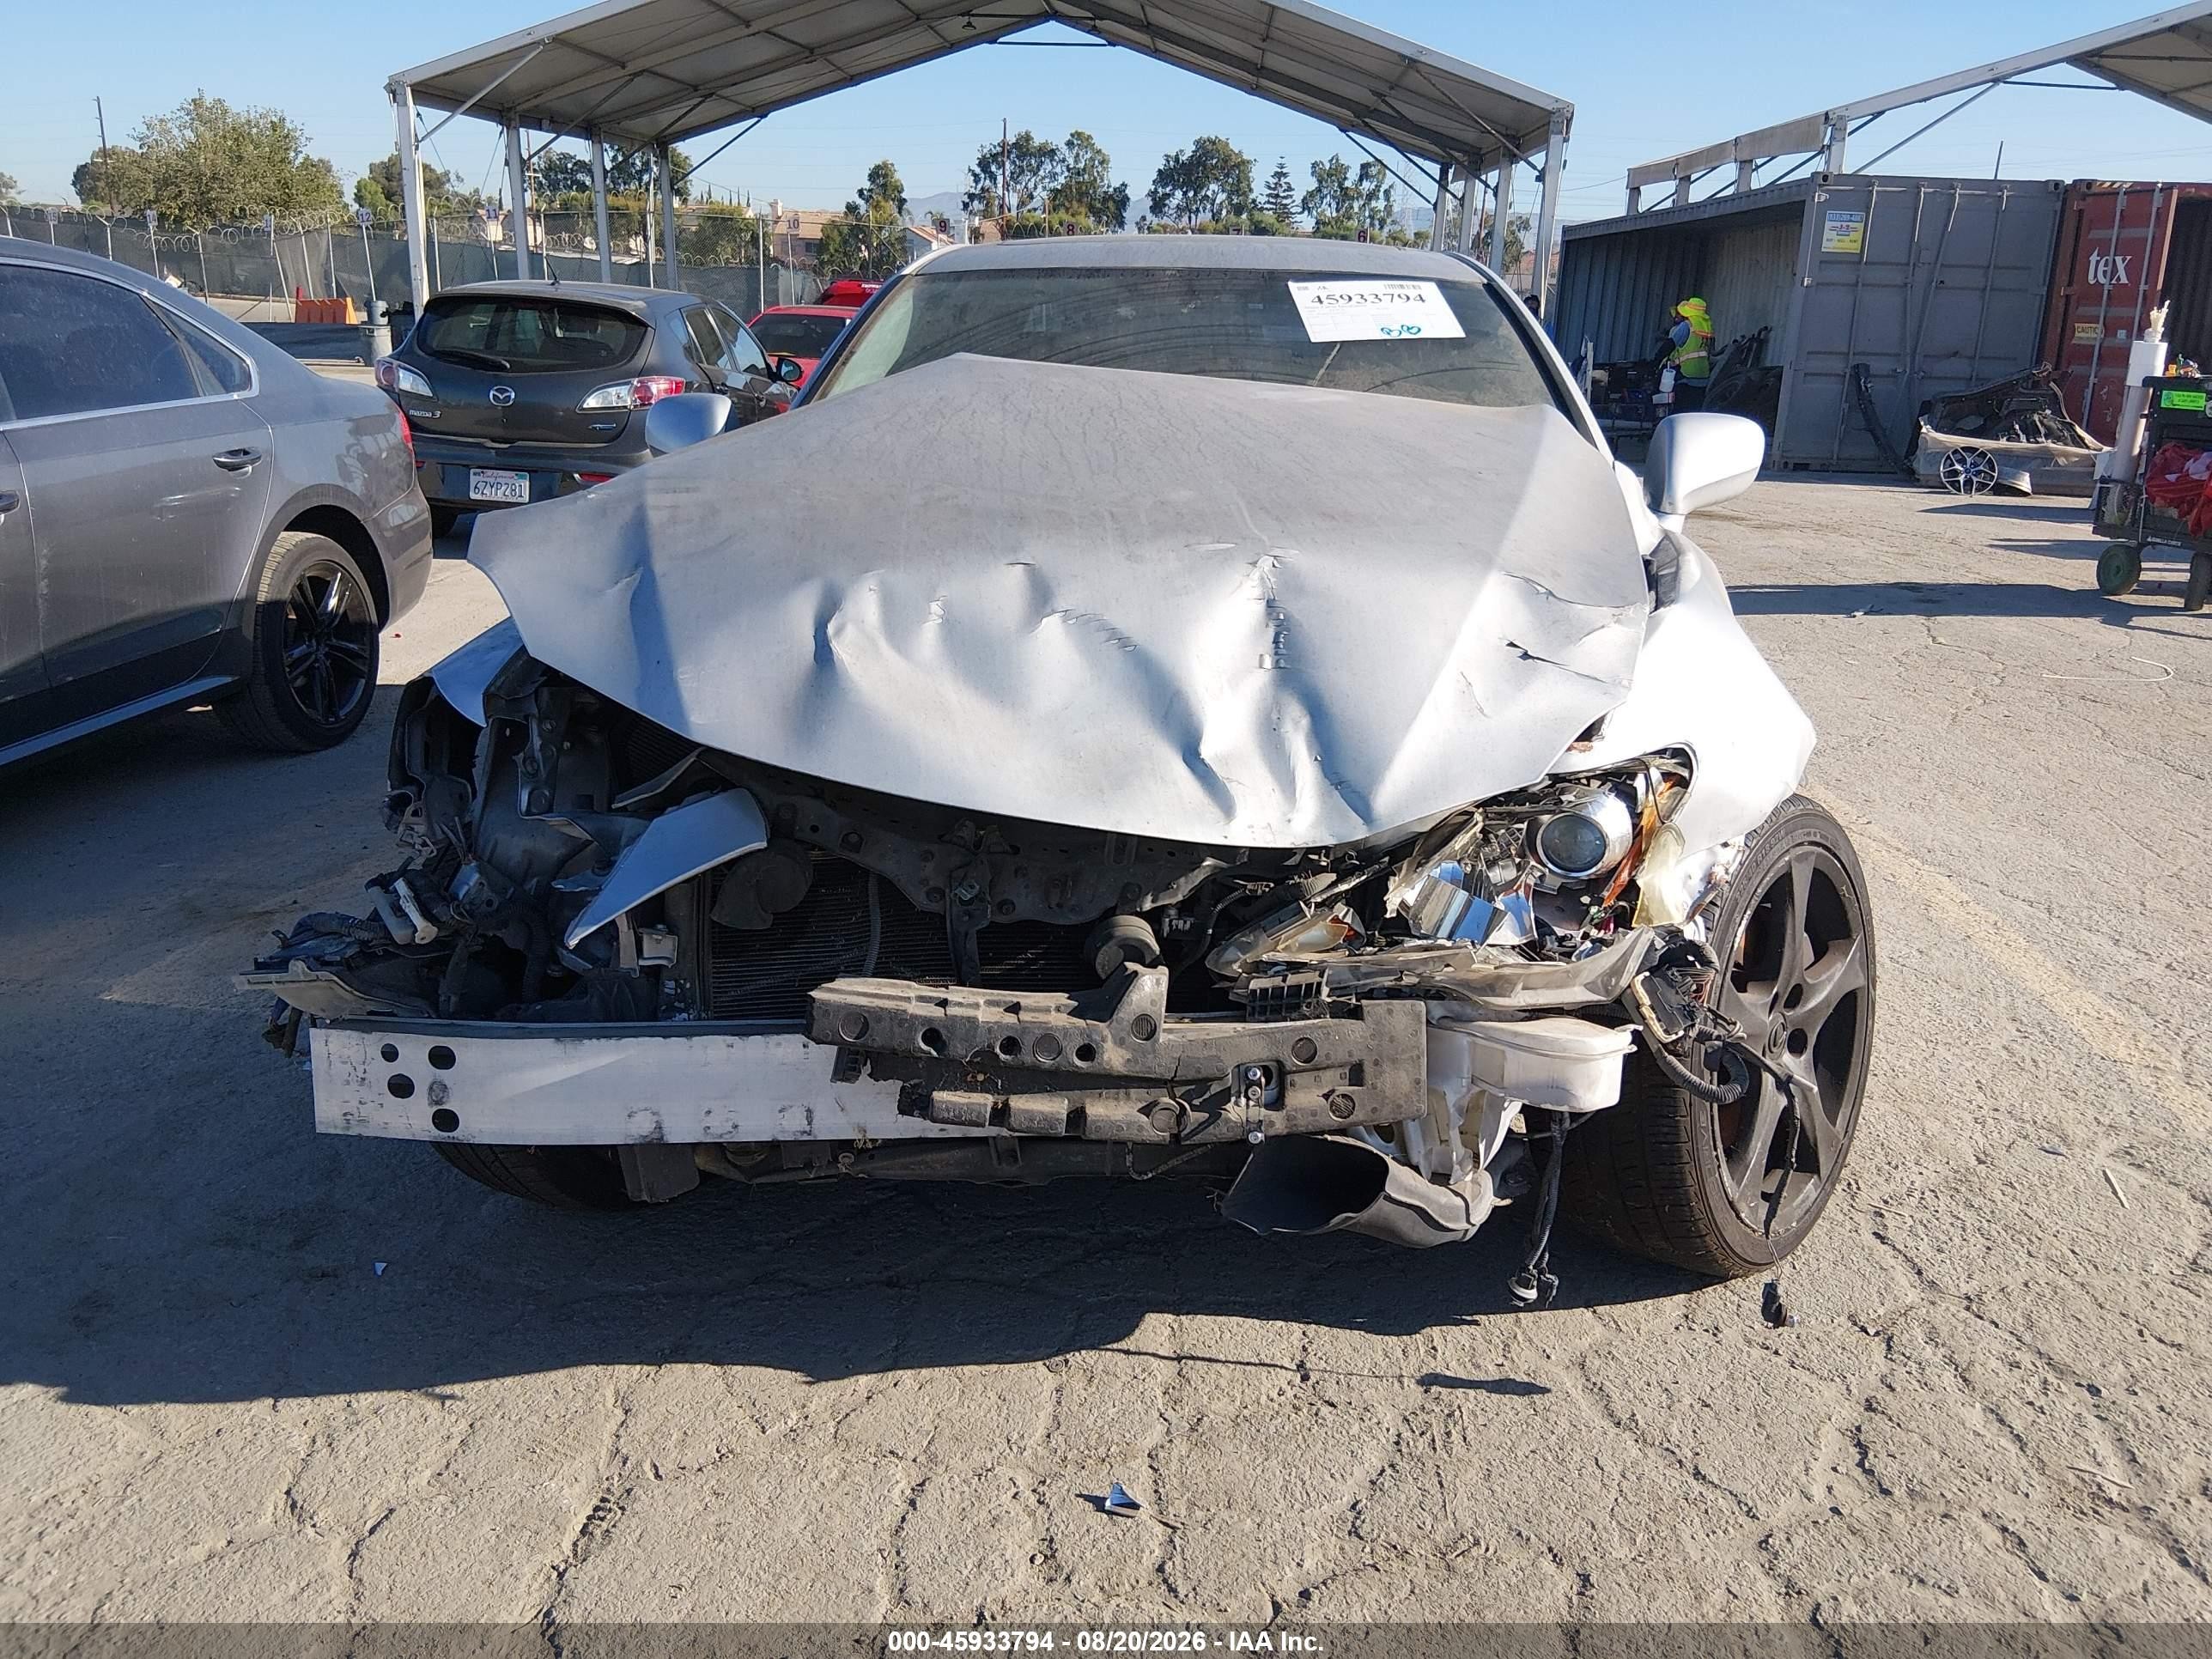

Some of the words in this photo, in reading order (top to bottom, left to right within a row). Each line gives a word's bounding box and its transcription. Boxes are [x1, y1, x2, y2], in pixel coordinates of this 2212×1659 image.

[360, 212, 371, 222] 12
[486, 208, 497, 219] 11
[787, 219, 799, 228] 10
[939, 220, 947, 233] 9
[1066, 223, 1074, 236] 8
[1358, 230, 1366, 242] 6
[2088, 247, 2132, 284] tex
[1311, 293, 1425, 305] 45933794
[473, 481, 525, 498] 6ZYP281
